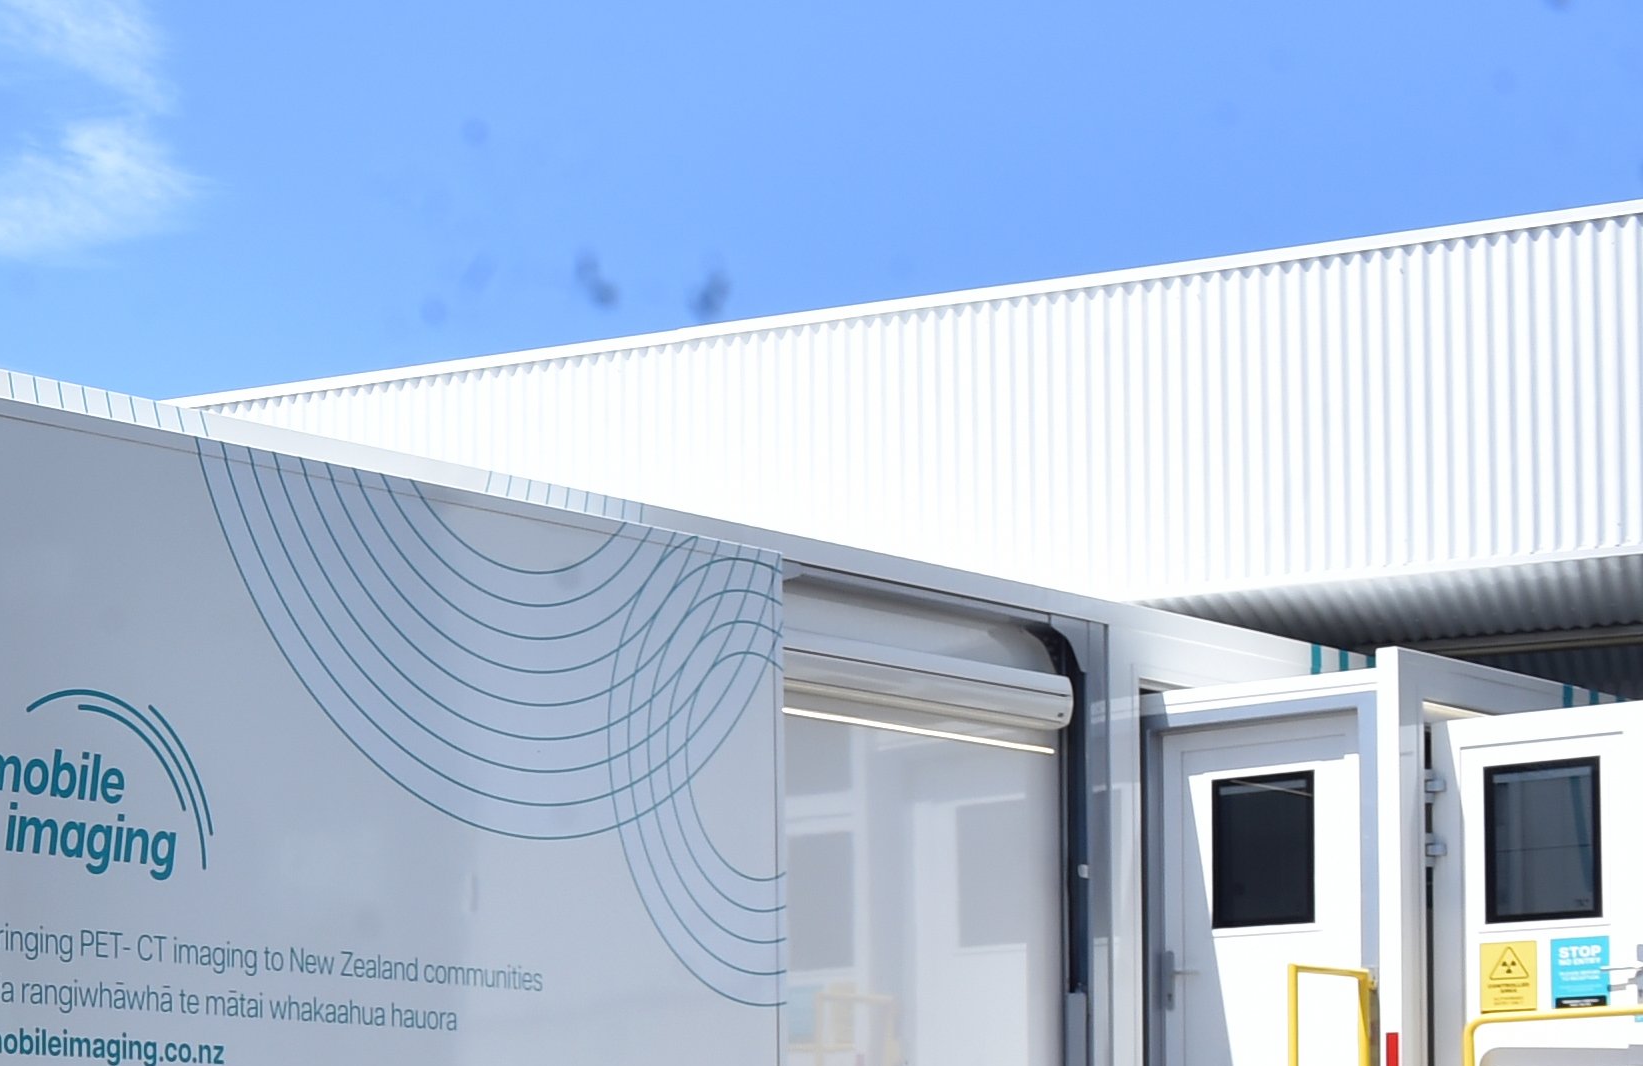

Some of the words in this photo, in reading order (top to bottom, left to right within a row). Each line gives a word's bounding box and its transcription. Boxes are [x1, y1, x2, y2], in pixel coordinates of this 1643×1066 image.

[5, 802, 177, 880] imaging
[80, 929, 131, 959] PET-
[137, 934, 167, 962] CT
[173, 936, 258, 976] imaging
[264, 946, 284, 972] to
[289, 946, 335, 976] New
[340, 950, 418, 982] Zealand
[423, 963, 543, 992] communities
[1558, 945, 1602, 959] STOP
[21, 979, 173, 1014] rangiwhāwhā
[179, 989, 200, 1014] te
[206, 990, 263, 1019] mātai
[269, 994, 386, 1027] whakaahua
[391, 1002, 457, 1031] hauora
